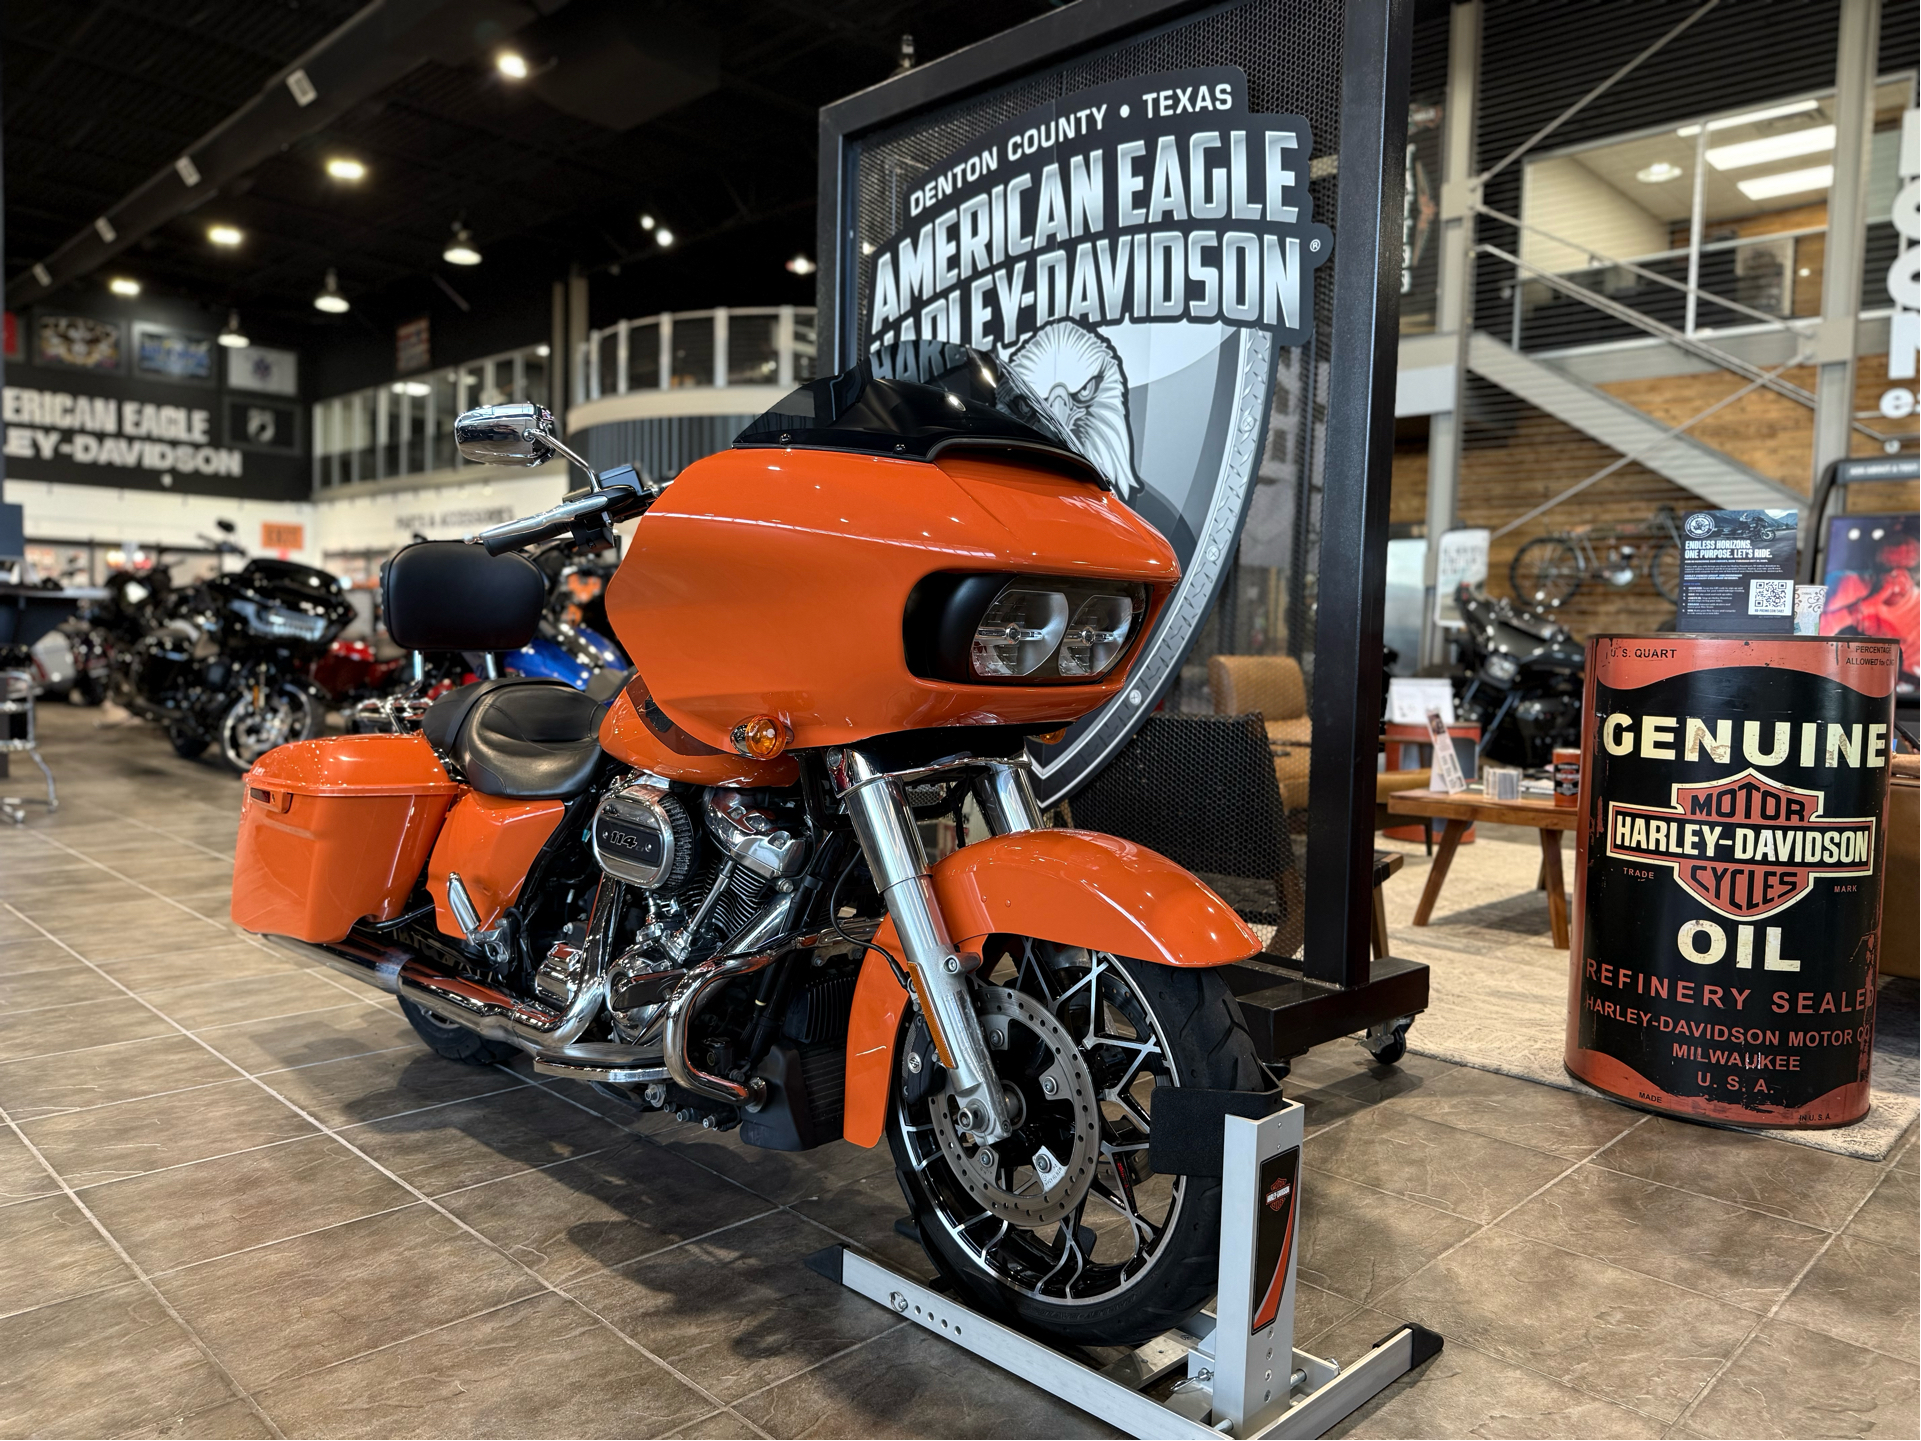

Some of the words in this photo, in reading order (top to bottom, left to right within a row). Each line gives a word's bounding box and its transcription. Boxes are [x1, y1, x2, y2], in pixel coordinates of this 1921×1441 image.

[910, 146, 998, 218] DENTON
[1007, 103, 1108, 162] COUNTY
[1142, 83, 1232, 119] TEXAS
[872, 149, 1104, 335] AMERICAN
[1117, 130, 1299, 228] EAGLE
[870, 230, 1300, 382] HARLEY-DAVIDSON
[121, 401, 210, 445] EAGLE
[1684, 549, 1699, 559] ONE
[1700, 549, 1733, 559] PURPOSE.
[1734, 549, 1753, 558] LET'S
[1754, 548, 1773, 558] RIDE.
[1685, 540, 1715, 550] ENDLESS
[1716, 540, 1753, 550] HORIZONS.
[1634, 648, 1678, 659] QUART
[1845, 657, 1879, 666] ALLOWED
[1855, 645, 1892, 654] PERCENTAGE
[1603, 713, 1888, 768] GENUINE
[1690, 781, 1806, 822] MOTOR
[610, 830, 638, 849] 114
[1615, 815, 1869, 863] HARLEY-DAVIDSON
[1623, 867, 1655, 880] TRADE
[1690, 864, 1798, 912] CYCLES
[1834, 885, 1858, 893] MARK
[1677, 919, 1801, 972] OIL
[1586, 957, 1752, 1010] REFINERY
[1771, 986, 1874, 1014] SEALED
[1585, 994, 1780, 1045] HARLEY-DAVIDSON
[1788, 1029, 1853, 1047] MOTOR
[1672, 1043, 1801, 1071] MILWAUKEE
[1638, 1091, 1662, 1104] MADE
[1799, 1114, 1808, 1122] IN
